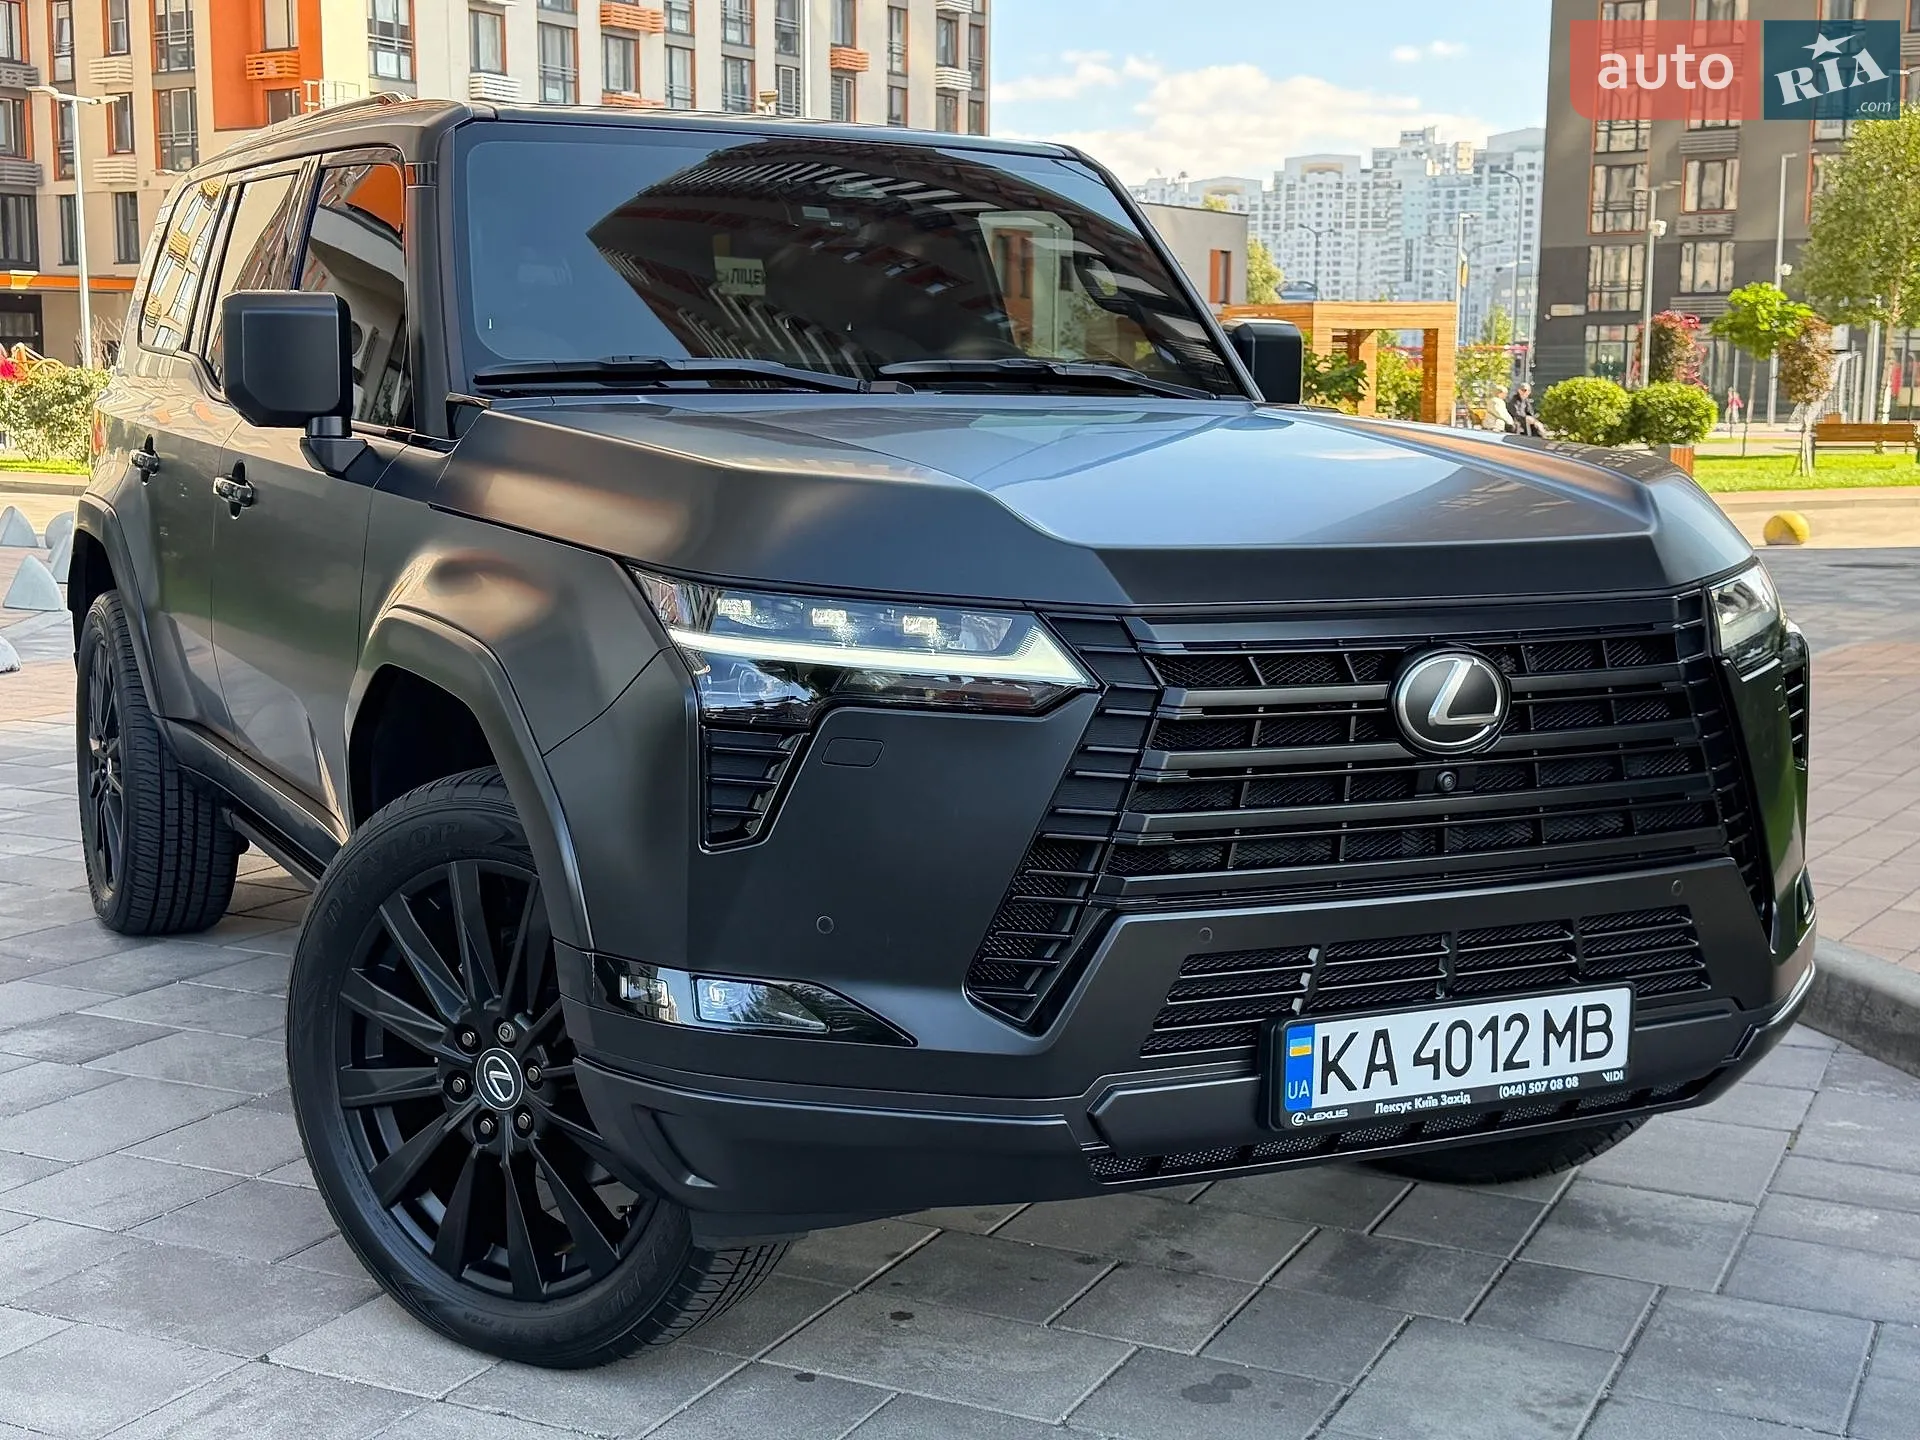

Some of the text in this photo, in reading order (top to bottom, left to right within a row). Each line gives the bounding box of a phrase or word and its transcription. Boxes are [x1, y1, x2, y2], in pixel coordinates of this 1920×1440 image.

[1319, 1003, 1614, 1095] KA 4012 MB
[1602, 1069, 1624, 1082] VIDI
[1287, 1079, 1311, 1100] UA
[1499, 1075, 1579, 1099] (044) 507 08 08
[1374, 1091, 1472, 1115] Лексус Київ Захід
[1306, 1108, 1349, 1122] LEXUS
